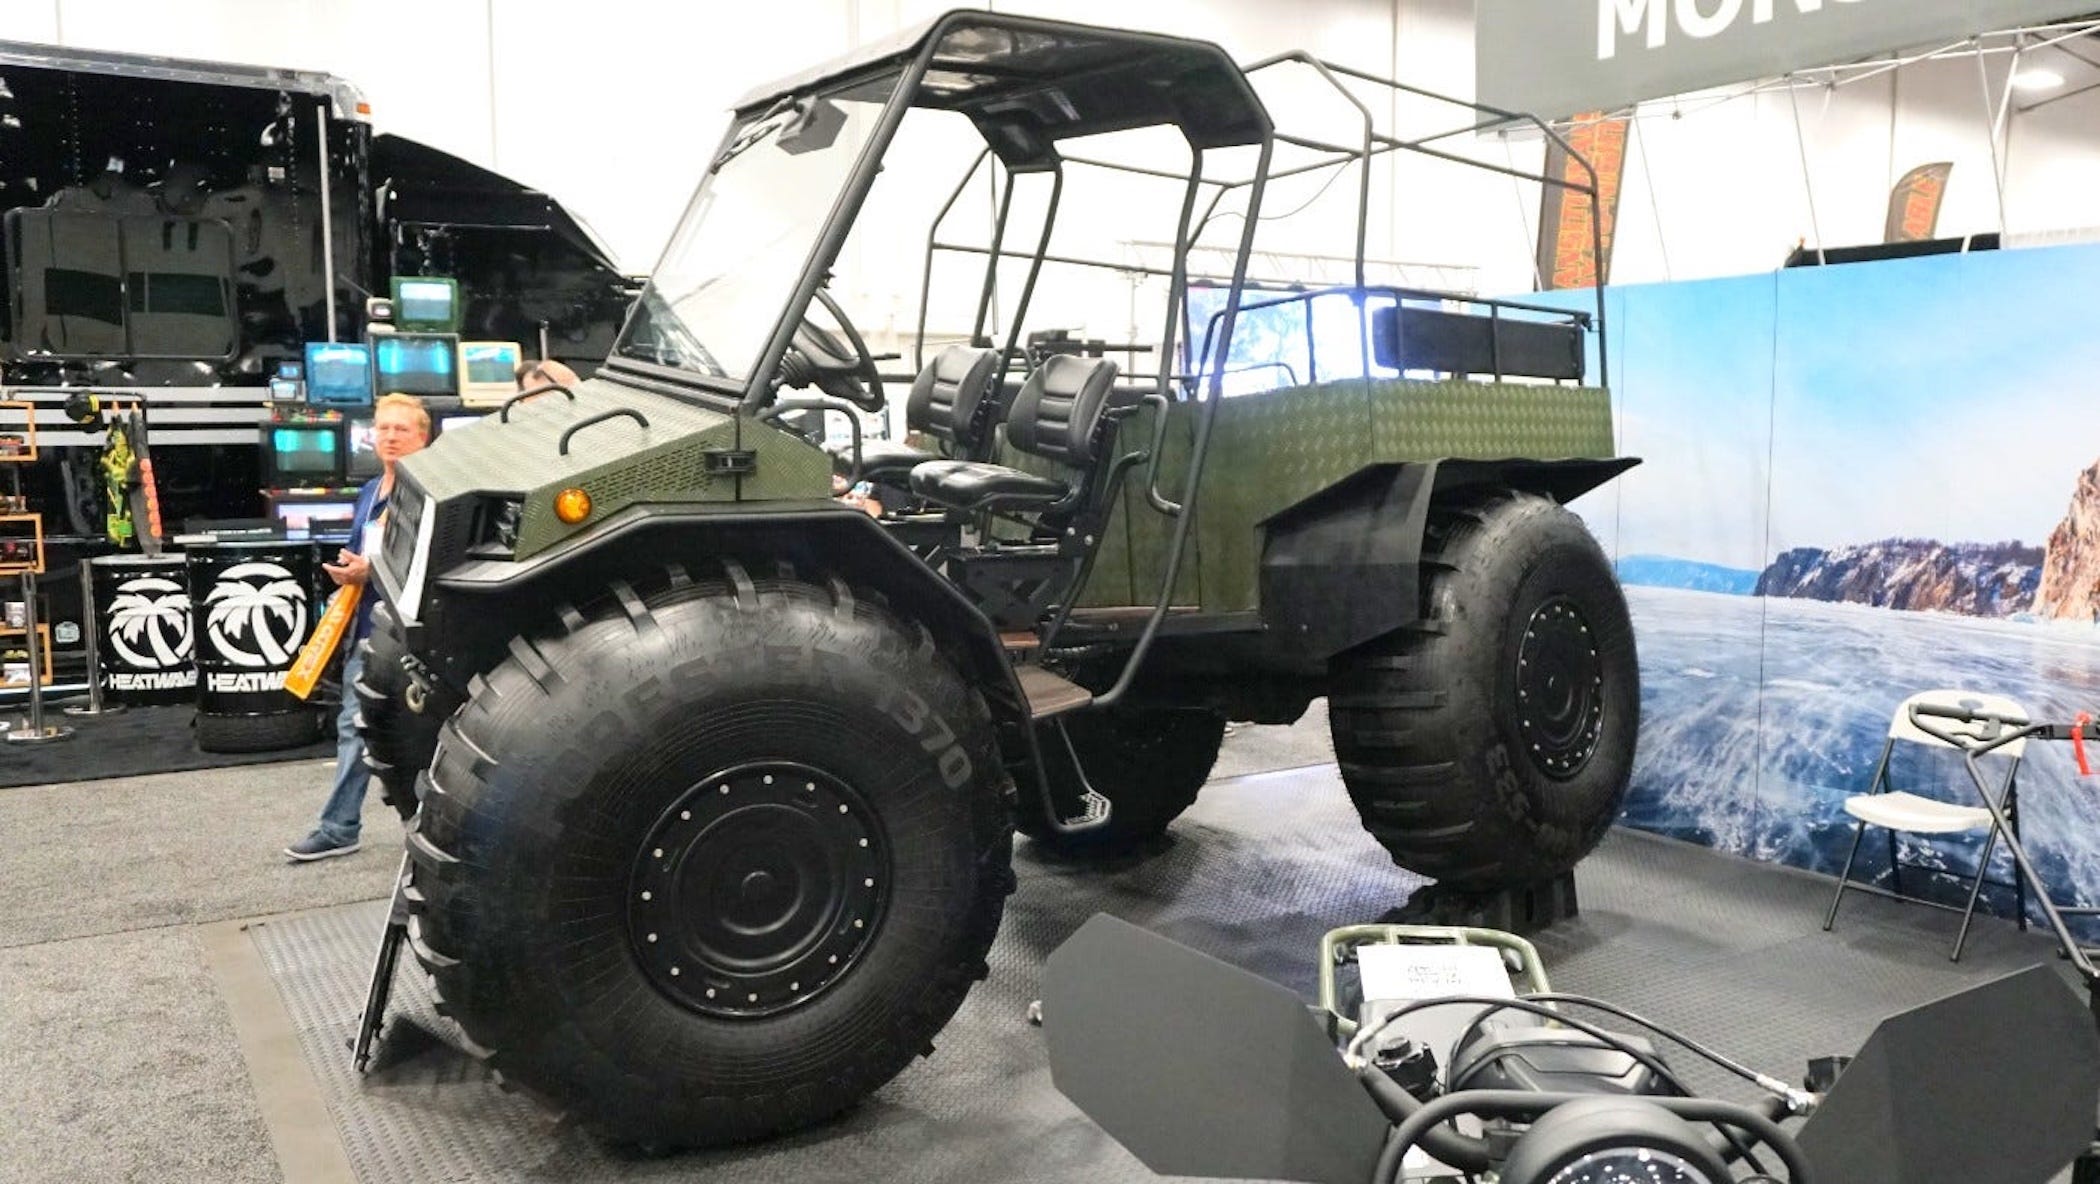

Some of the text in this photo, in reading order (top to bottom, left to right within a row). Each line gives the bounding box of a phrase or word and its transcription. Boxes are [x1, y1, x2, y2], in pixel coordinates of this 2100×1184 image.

[1597, 0, 1868, 60] MO
[109, 670, 198, 690] HEATWAVE
[206, 670, 289, 692] HEATW
[540, 643, 848, 838] ORESTER
